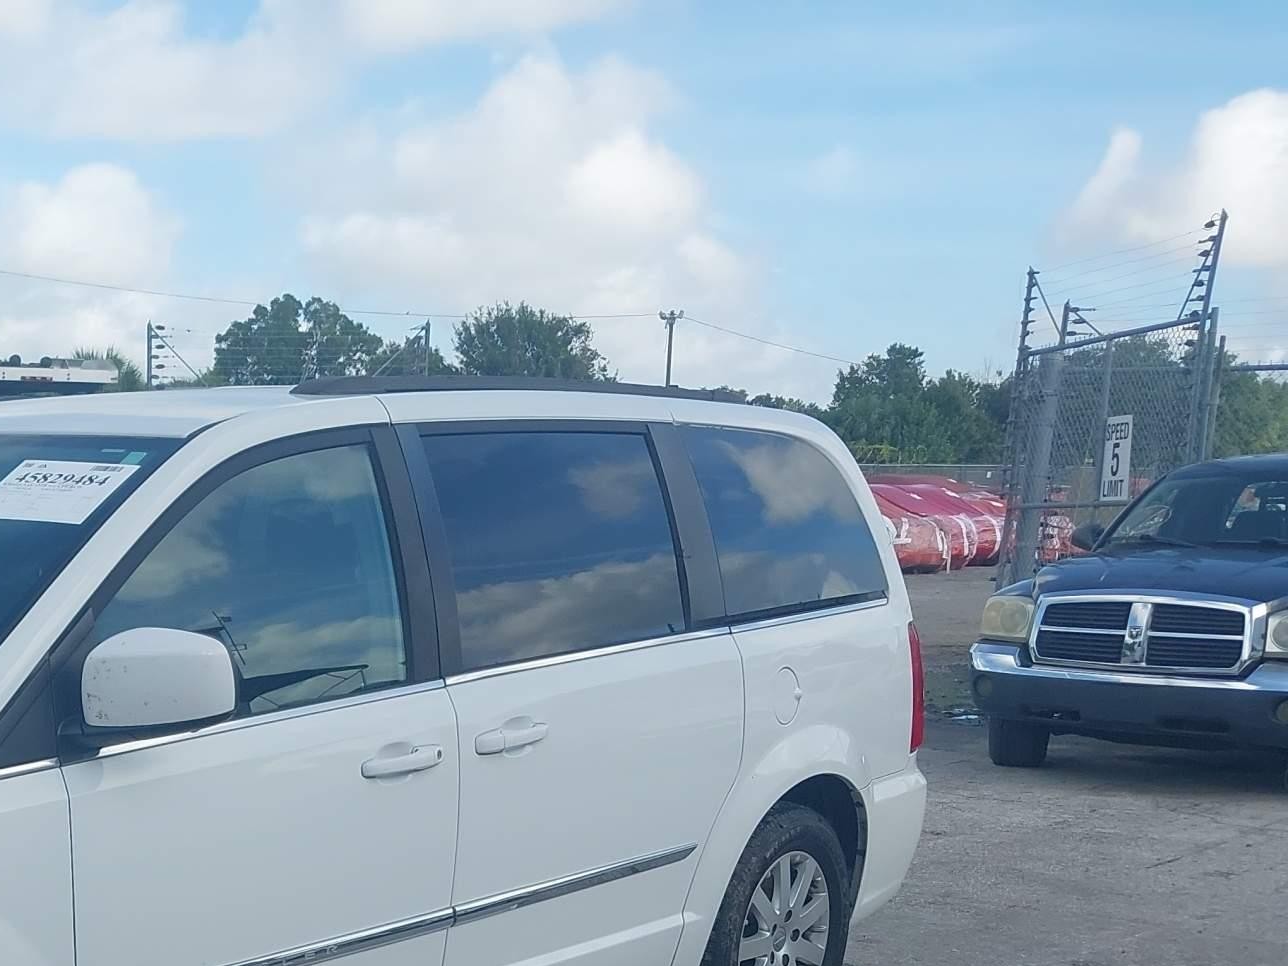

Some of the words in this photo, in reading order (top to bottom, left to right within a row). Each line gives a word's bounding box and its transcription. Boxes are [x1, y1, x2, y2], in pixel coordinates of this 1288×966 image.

[1106, 422, 1130, 441] SPEED
[1110, 442, 1121, 477] 5
[15, 472, 112, 487] 45829484
[1102, 479, 1125, 497] LIMIT
